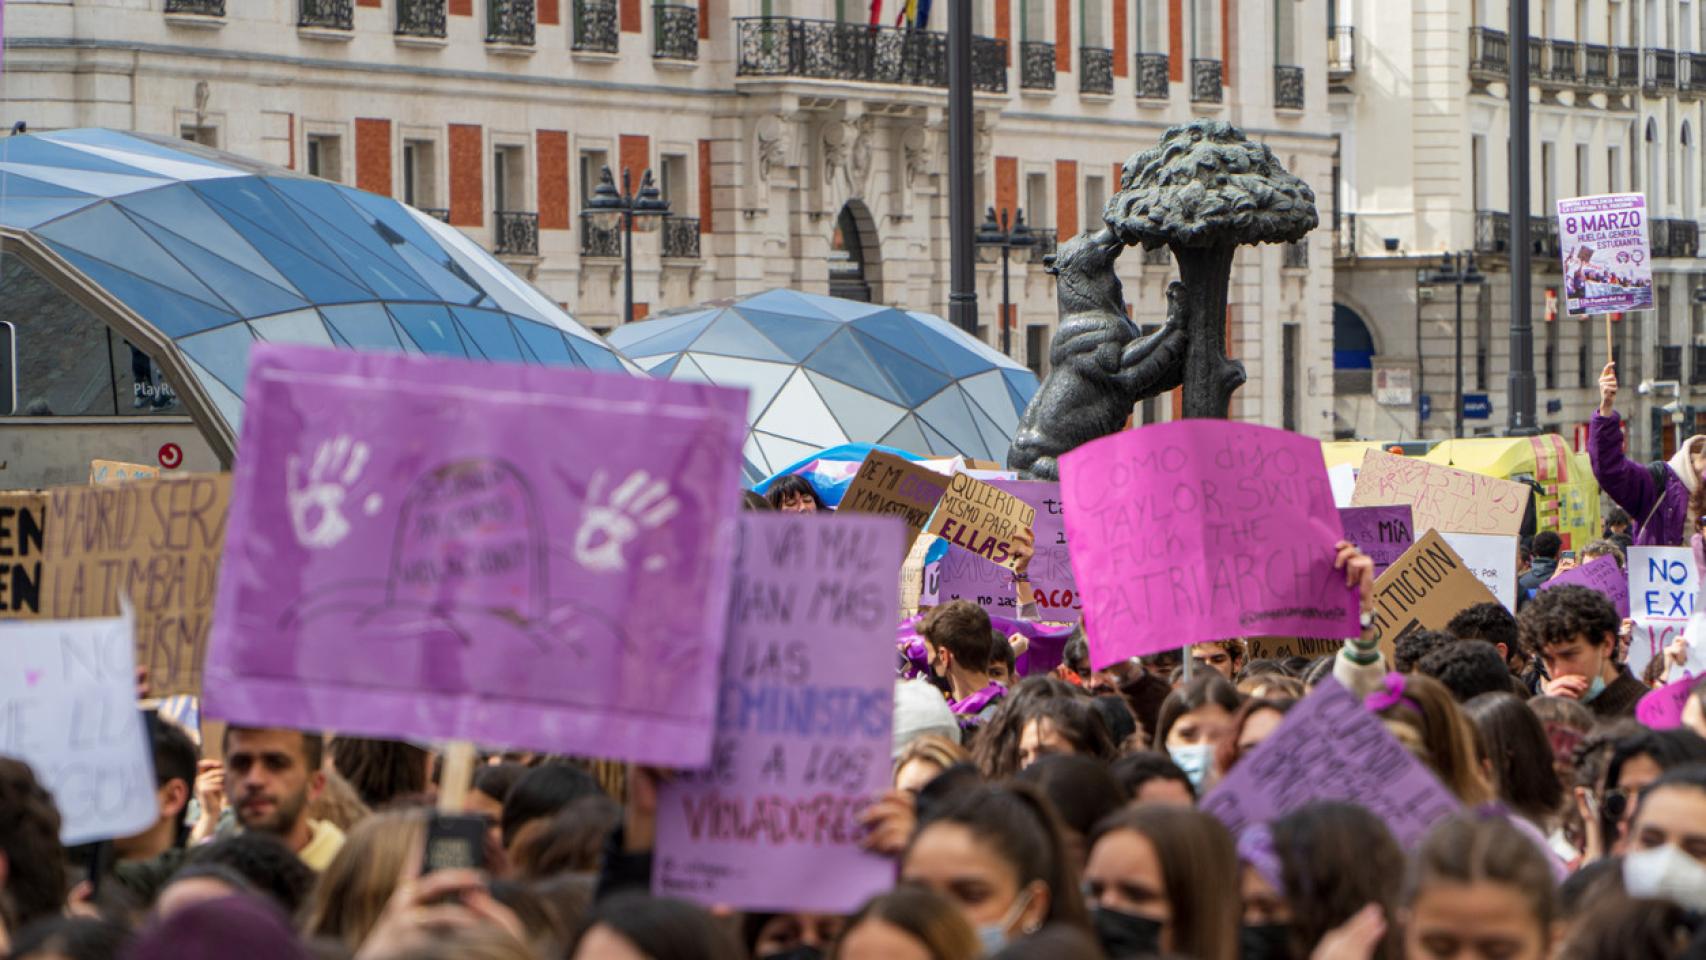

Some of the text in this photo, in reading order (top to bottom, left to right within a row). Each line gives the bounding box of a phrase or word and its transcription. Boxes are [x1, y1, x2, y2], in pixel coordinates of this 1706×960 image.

[1566, 211, 1641, 234] 8 MARZO
[1578, 230, 1642, 243] HUELGA GENERAL
[1597, 238, 1643, 250] ESTUDIANTIL
[952, 471, 1016, 516] QUIERO
[1019, 504, 1035, 527] LO
[1076, 445, 1188, 512] COMO
[46, 481, 140, 560] MADRID
[942, 492, 1018, 540] MISMO PARA
[1091, 479, 1223, 546] TAYLOR
[1378, 518, 1411, 544] MÍA
[1112, 514, 1273, 575] FUCK THE
[53, 561, 85, 618] LA
[1090, 543, 1339, 636] PATRIARCHY
[1482, 568, 1497, 577] POR
[1648, 557, 1688, 586] NO
[977, 596, 992, 606] no
